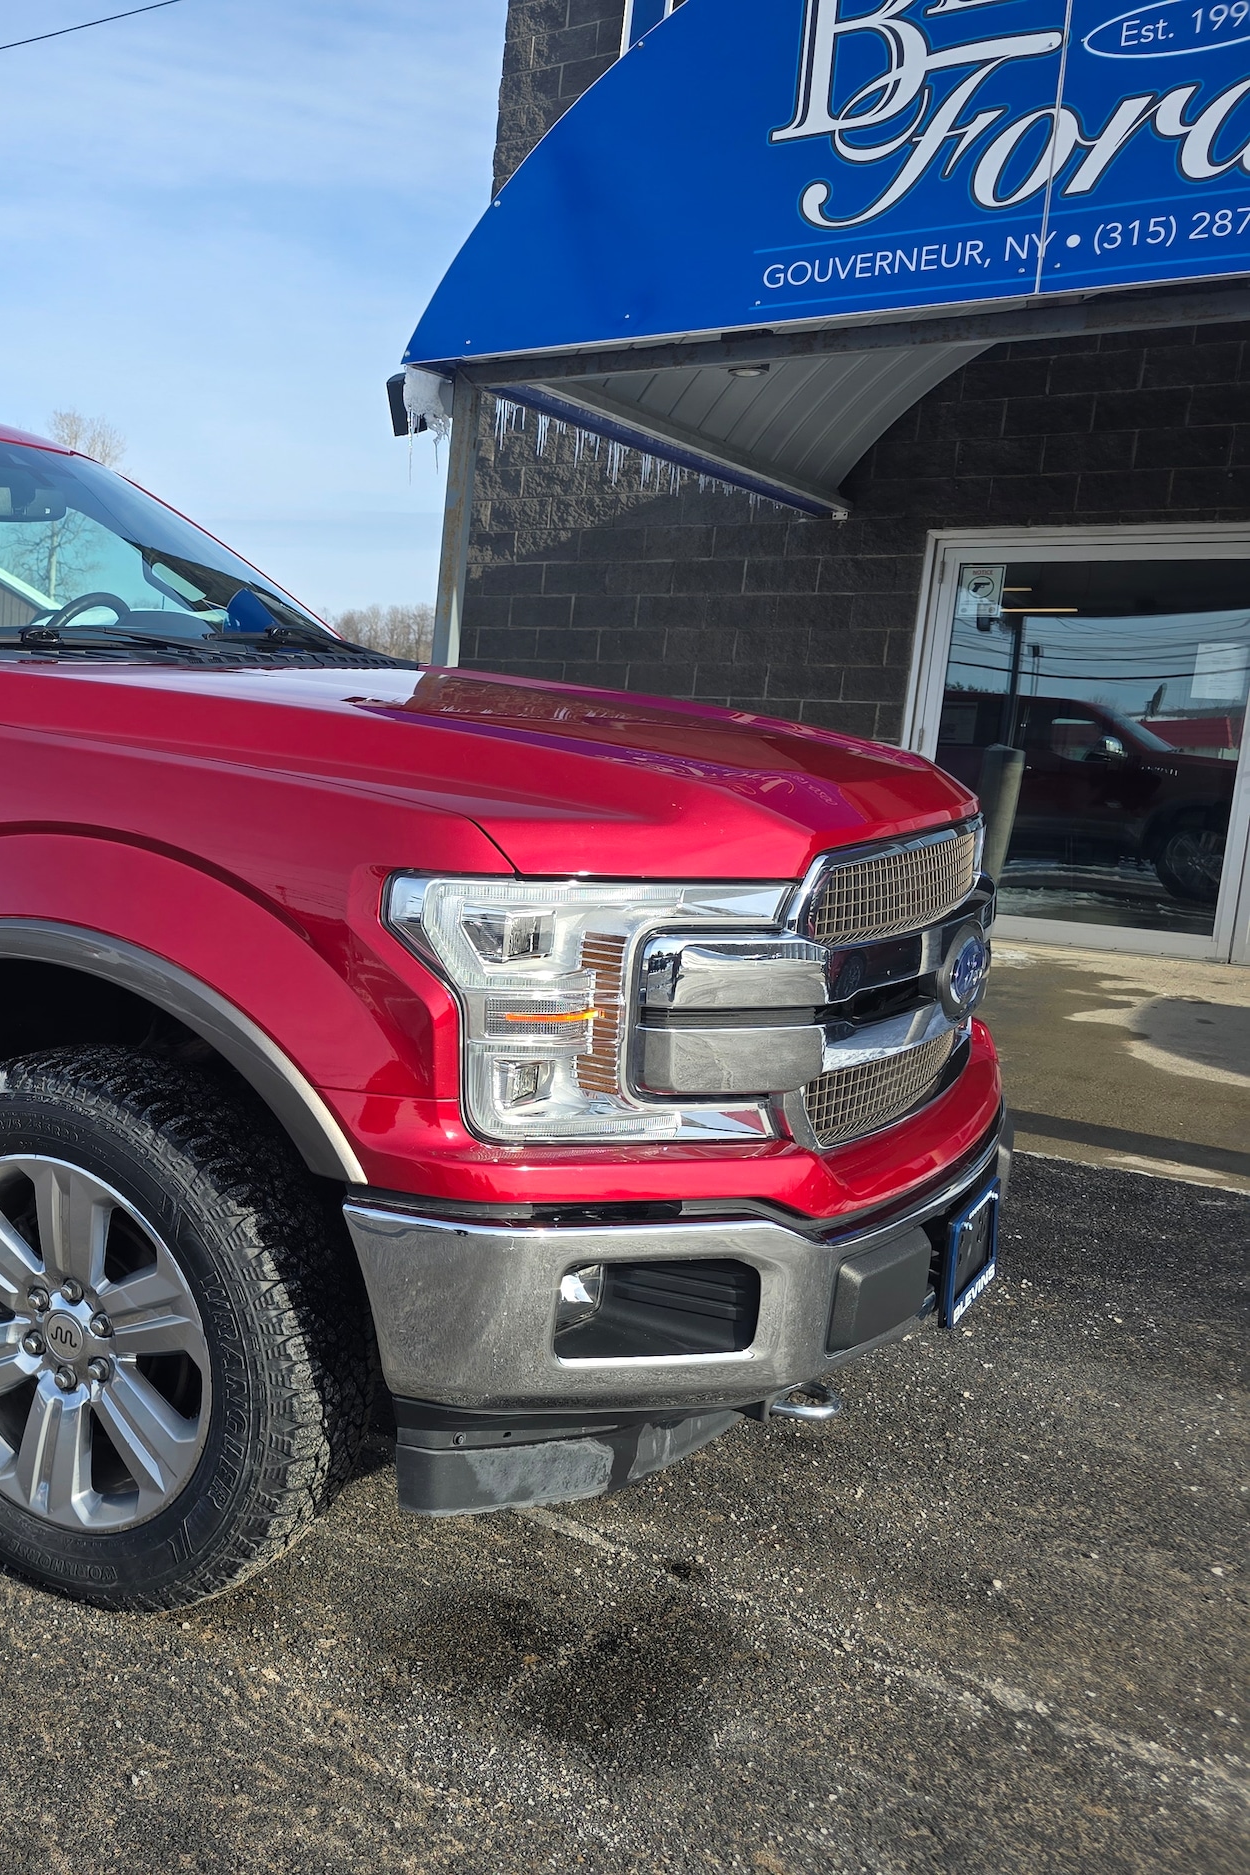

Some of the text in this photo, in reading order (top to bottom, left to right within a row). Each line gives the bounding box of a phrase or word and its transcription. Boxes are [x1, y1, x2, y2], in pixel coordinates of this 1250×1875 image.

[1120, 0, 1250, 47] Est. 199
[762, 239, 992, 289] GOUVERNEUR,
[1004, 230, 1058, 262] NY
[1093, 214, 1177, 256] (315)
[953, 1263, 996, 1325] BLEVINS
[199, 1270, 249, 1511] WRANGLER
[6, 1538, 119, 1581] WORKHORSE
